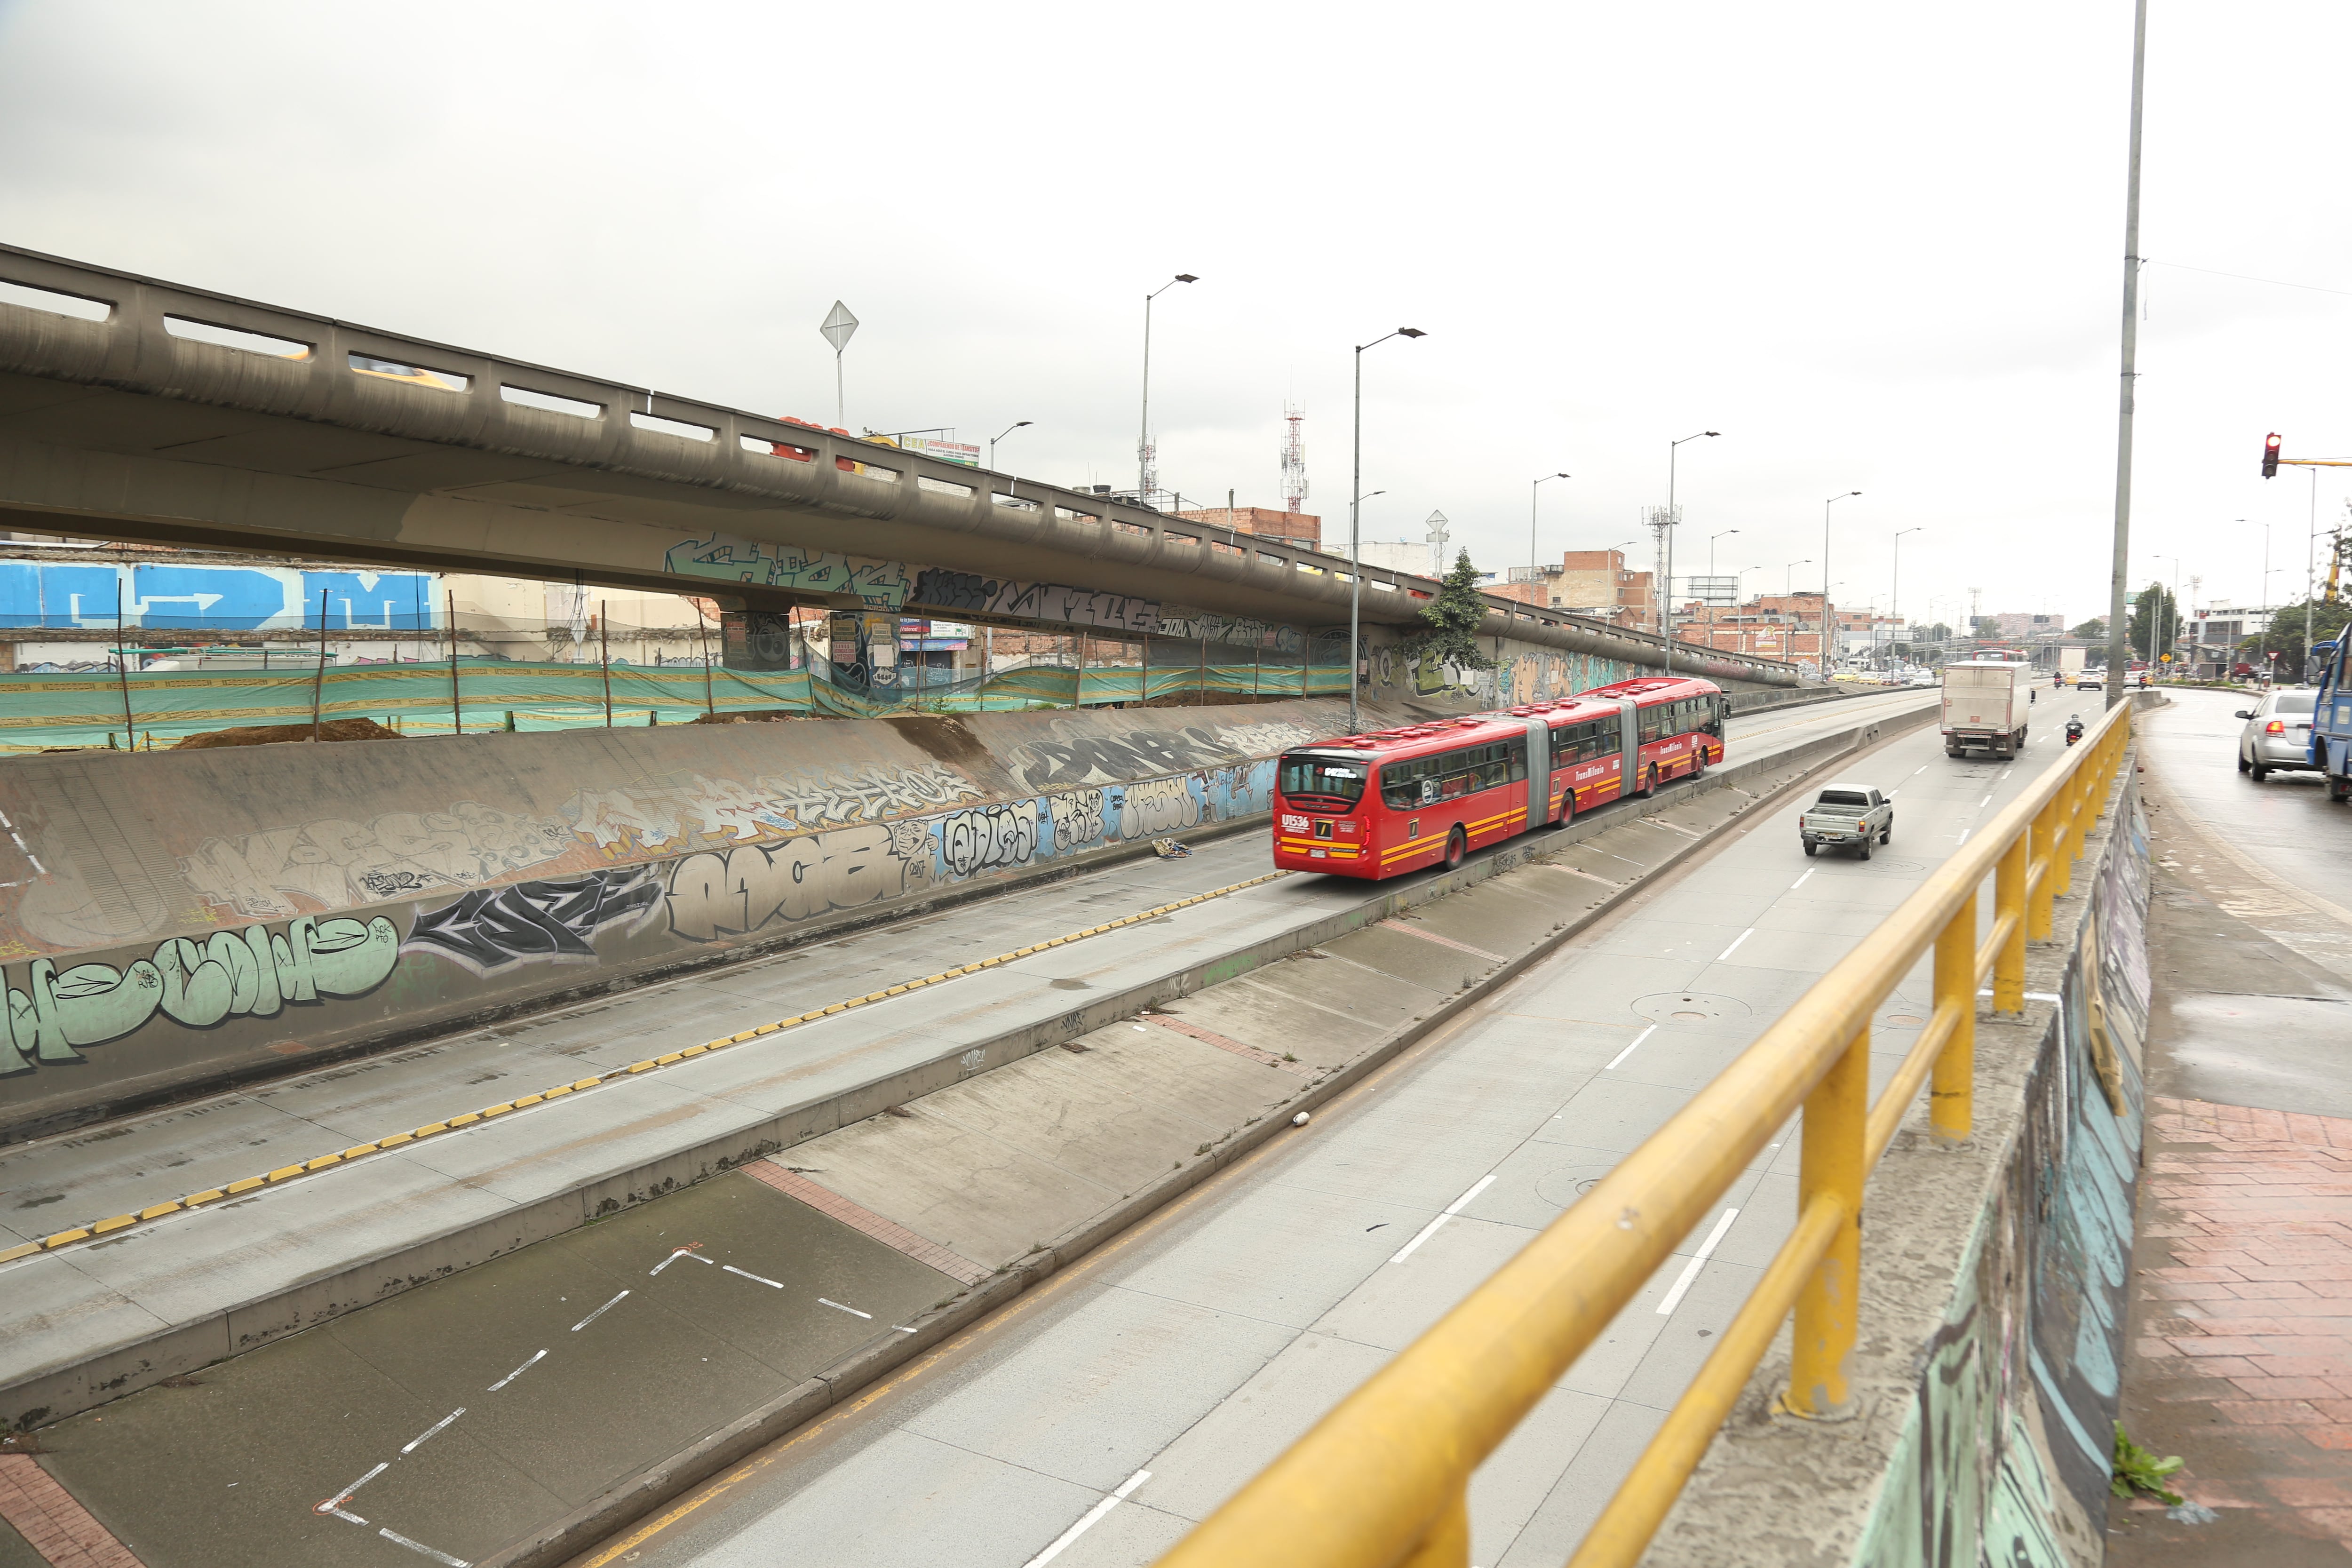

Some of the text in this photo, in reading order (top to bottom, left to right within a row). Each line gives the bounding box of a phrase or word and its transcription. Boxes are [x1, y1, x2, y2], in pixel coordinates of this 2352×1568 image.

[904, 437, 925, 450] CEA
[928, 441, 954, 450] ¿COMPARENDO
[1660, 741, 1682, 755] TransMilenio
[1575, 765, 1604, 781] TransMilenio
